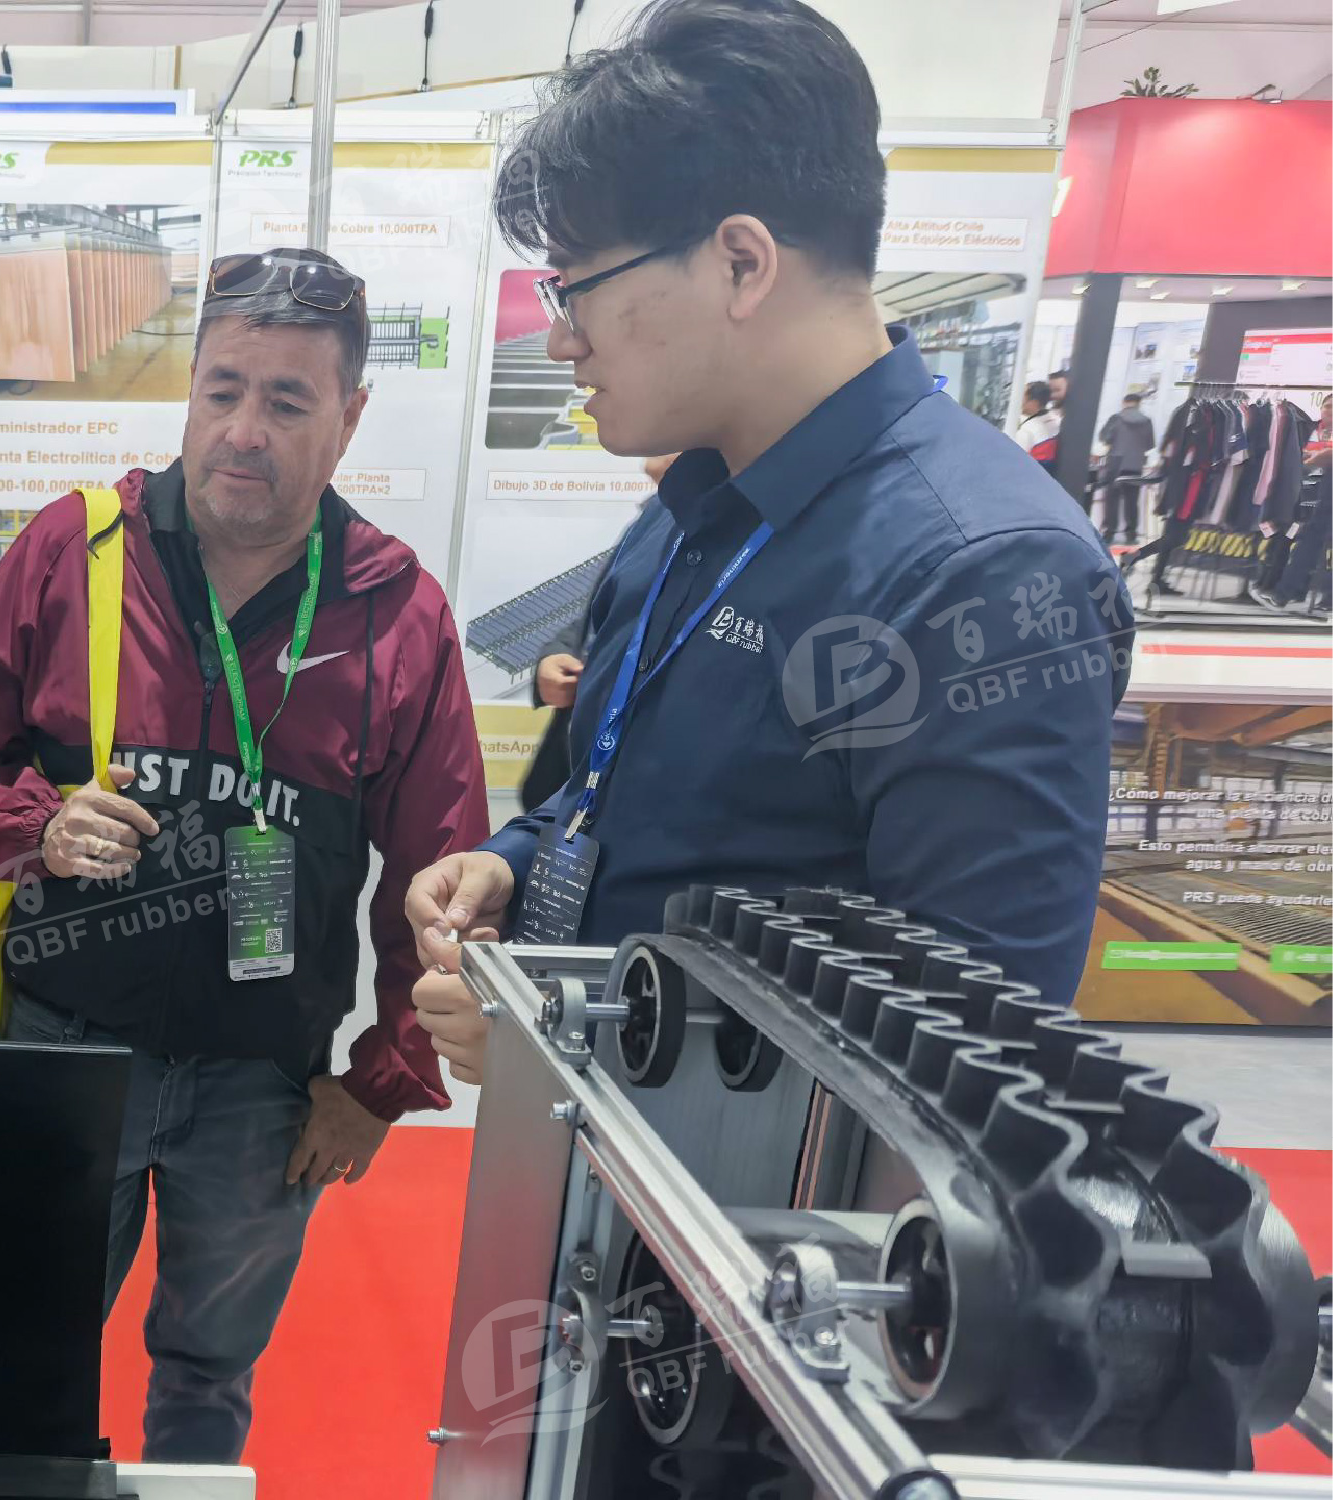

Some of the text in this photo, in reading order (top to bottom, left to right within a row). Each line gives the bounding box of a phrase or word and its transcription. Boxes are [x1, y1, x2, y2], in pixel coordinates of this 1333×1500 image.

[238, 149, 298, 168] PRS
[340, 222, 375, 234] Cobre
[87, 422, 119, 435] EPC
[121, 452, 139, 465] de
[493, 479, 529, 493] Dibujo
[532, 480, 547, 491] 3D
[549, 480, 564, 491] de
[567, 480, 605, 491] Bolivia
[266, 779, 300, 827] IT.
[1138, 839, 1172, 852] Esto
[1185, 859, 1222, 872] agua
[1224, 860, 1234, 873] y
[1283, 860, 1303, 872] de
[1183, 892, 1214, 904] PRS
[1216, 894, 1265, 906] puede
